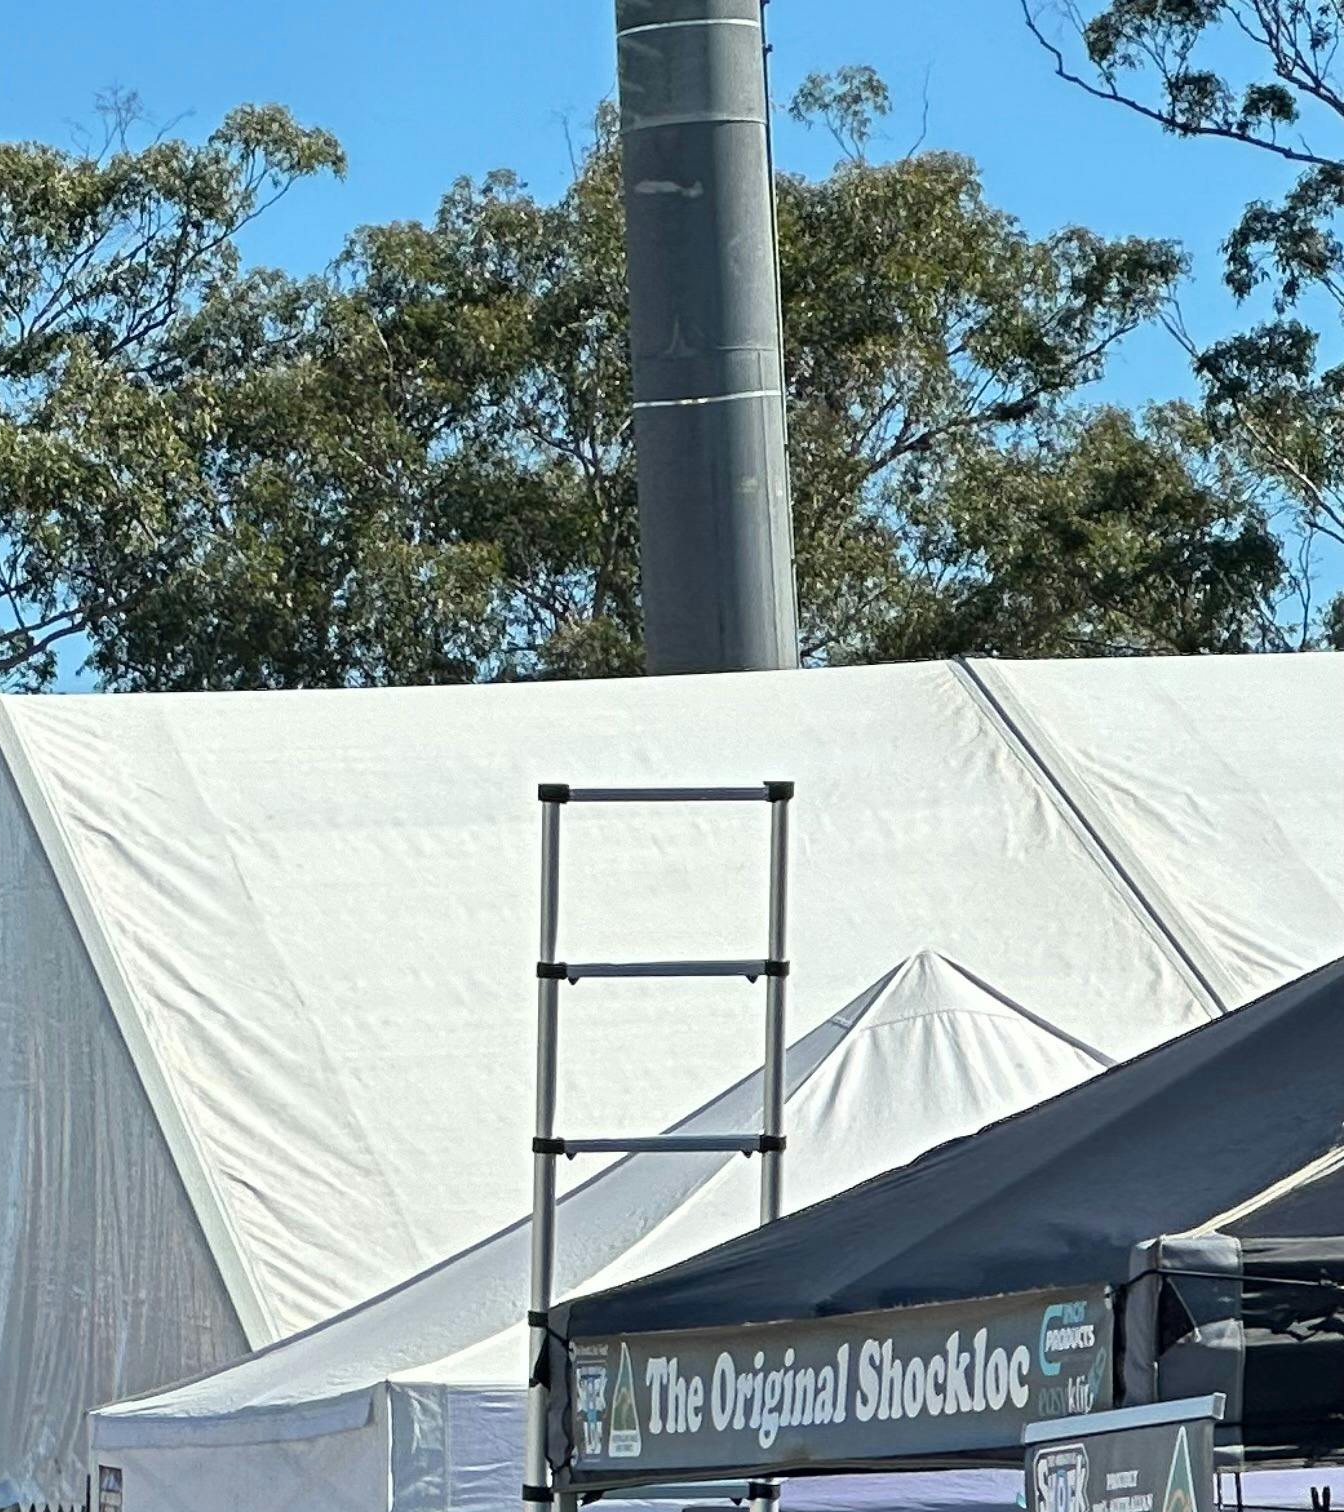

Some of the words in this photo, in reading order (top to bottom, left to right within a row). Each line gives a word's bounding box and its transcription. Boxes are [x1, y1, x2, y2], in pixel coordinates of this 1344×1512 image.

[645, 1356, 705, 1435] The
[712, 1343, 849, 1449] Original
[856, 1327, 1030, 1422] Shockloc
